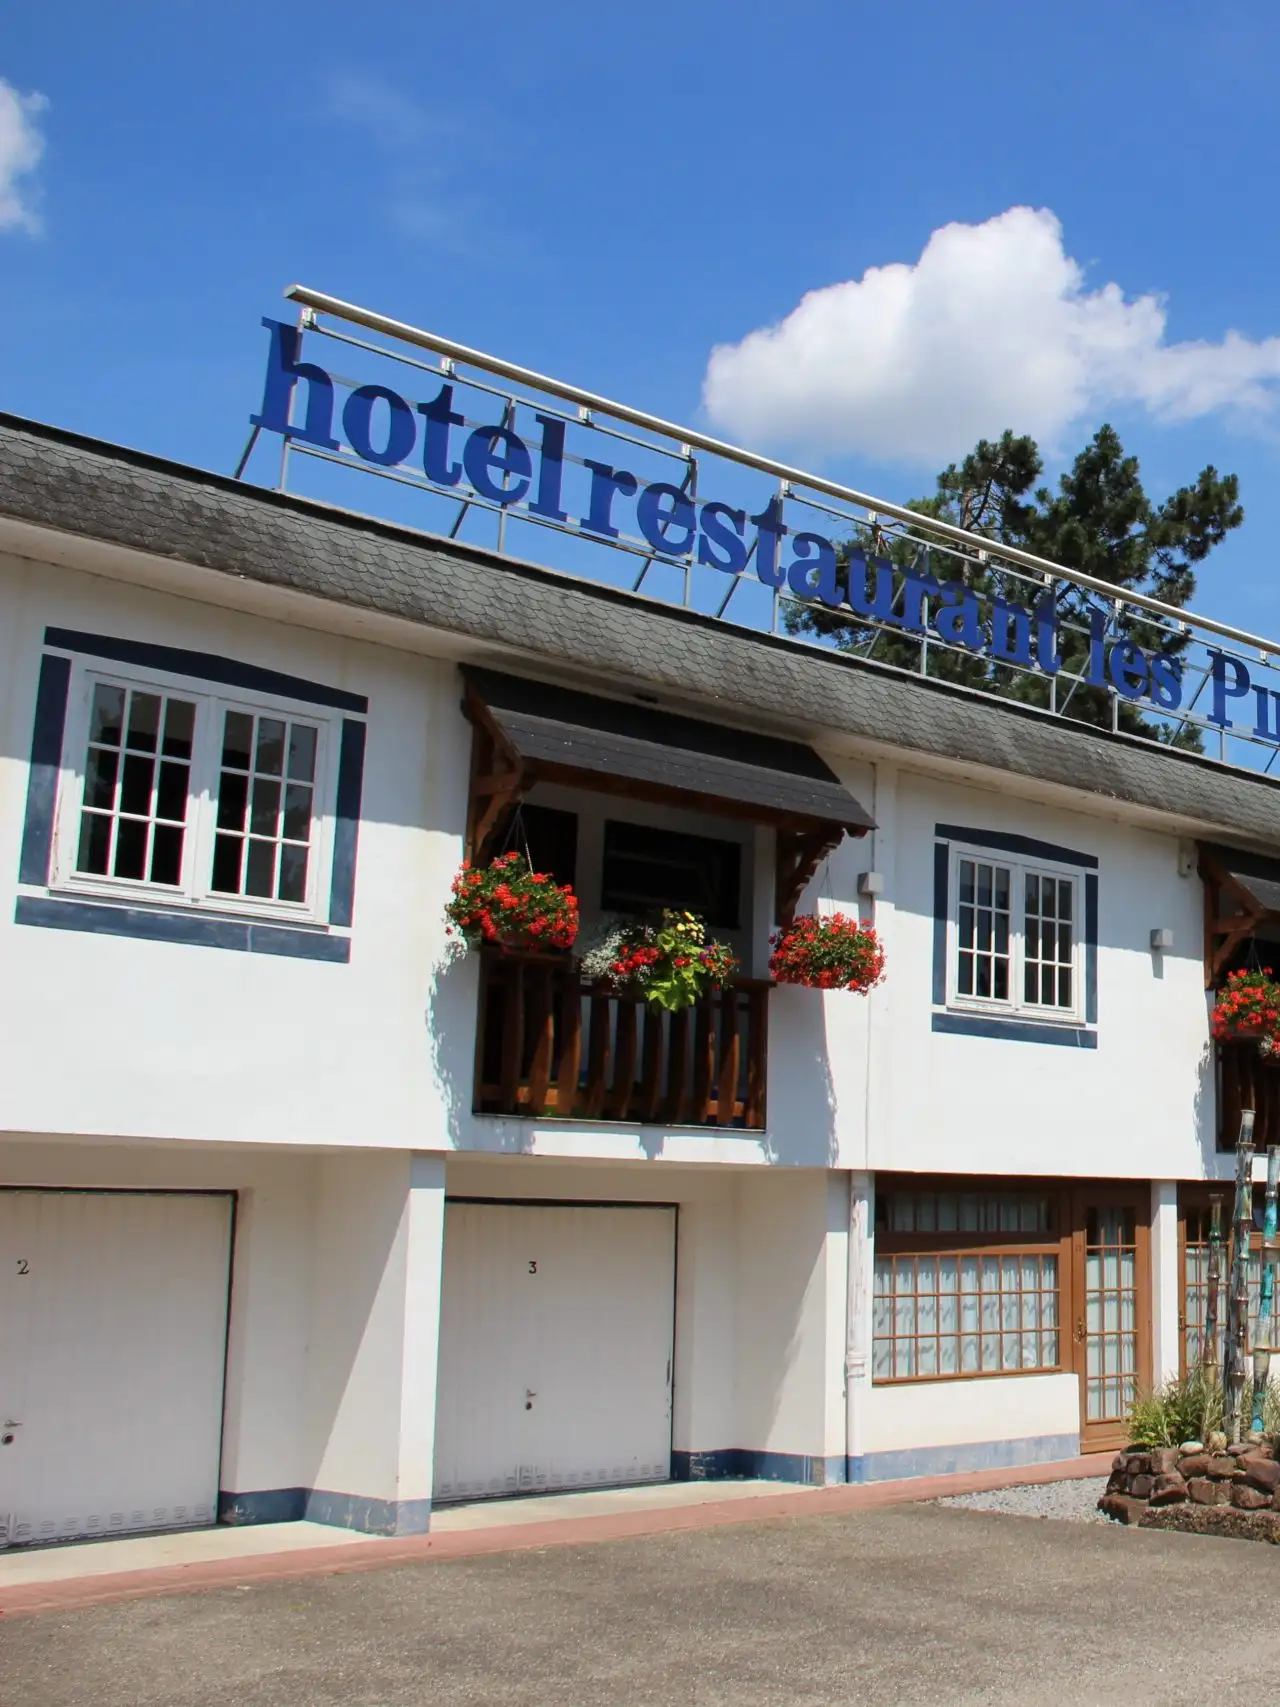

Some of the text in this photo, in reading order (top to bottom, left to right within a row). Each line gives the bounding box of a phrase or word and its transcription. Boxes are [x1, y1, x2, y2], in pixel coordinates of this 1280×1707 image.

[250, 317, 567, 522] hotel
[580, 458, 1062, 673] restaurant
[1086, 606, 1182, 710] les
[16, 1259, 30, 1275] 2
[528, 1260, 537, 1274] 3
